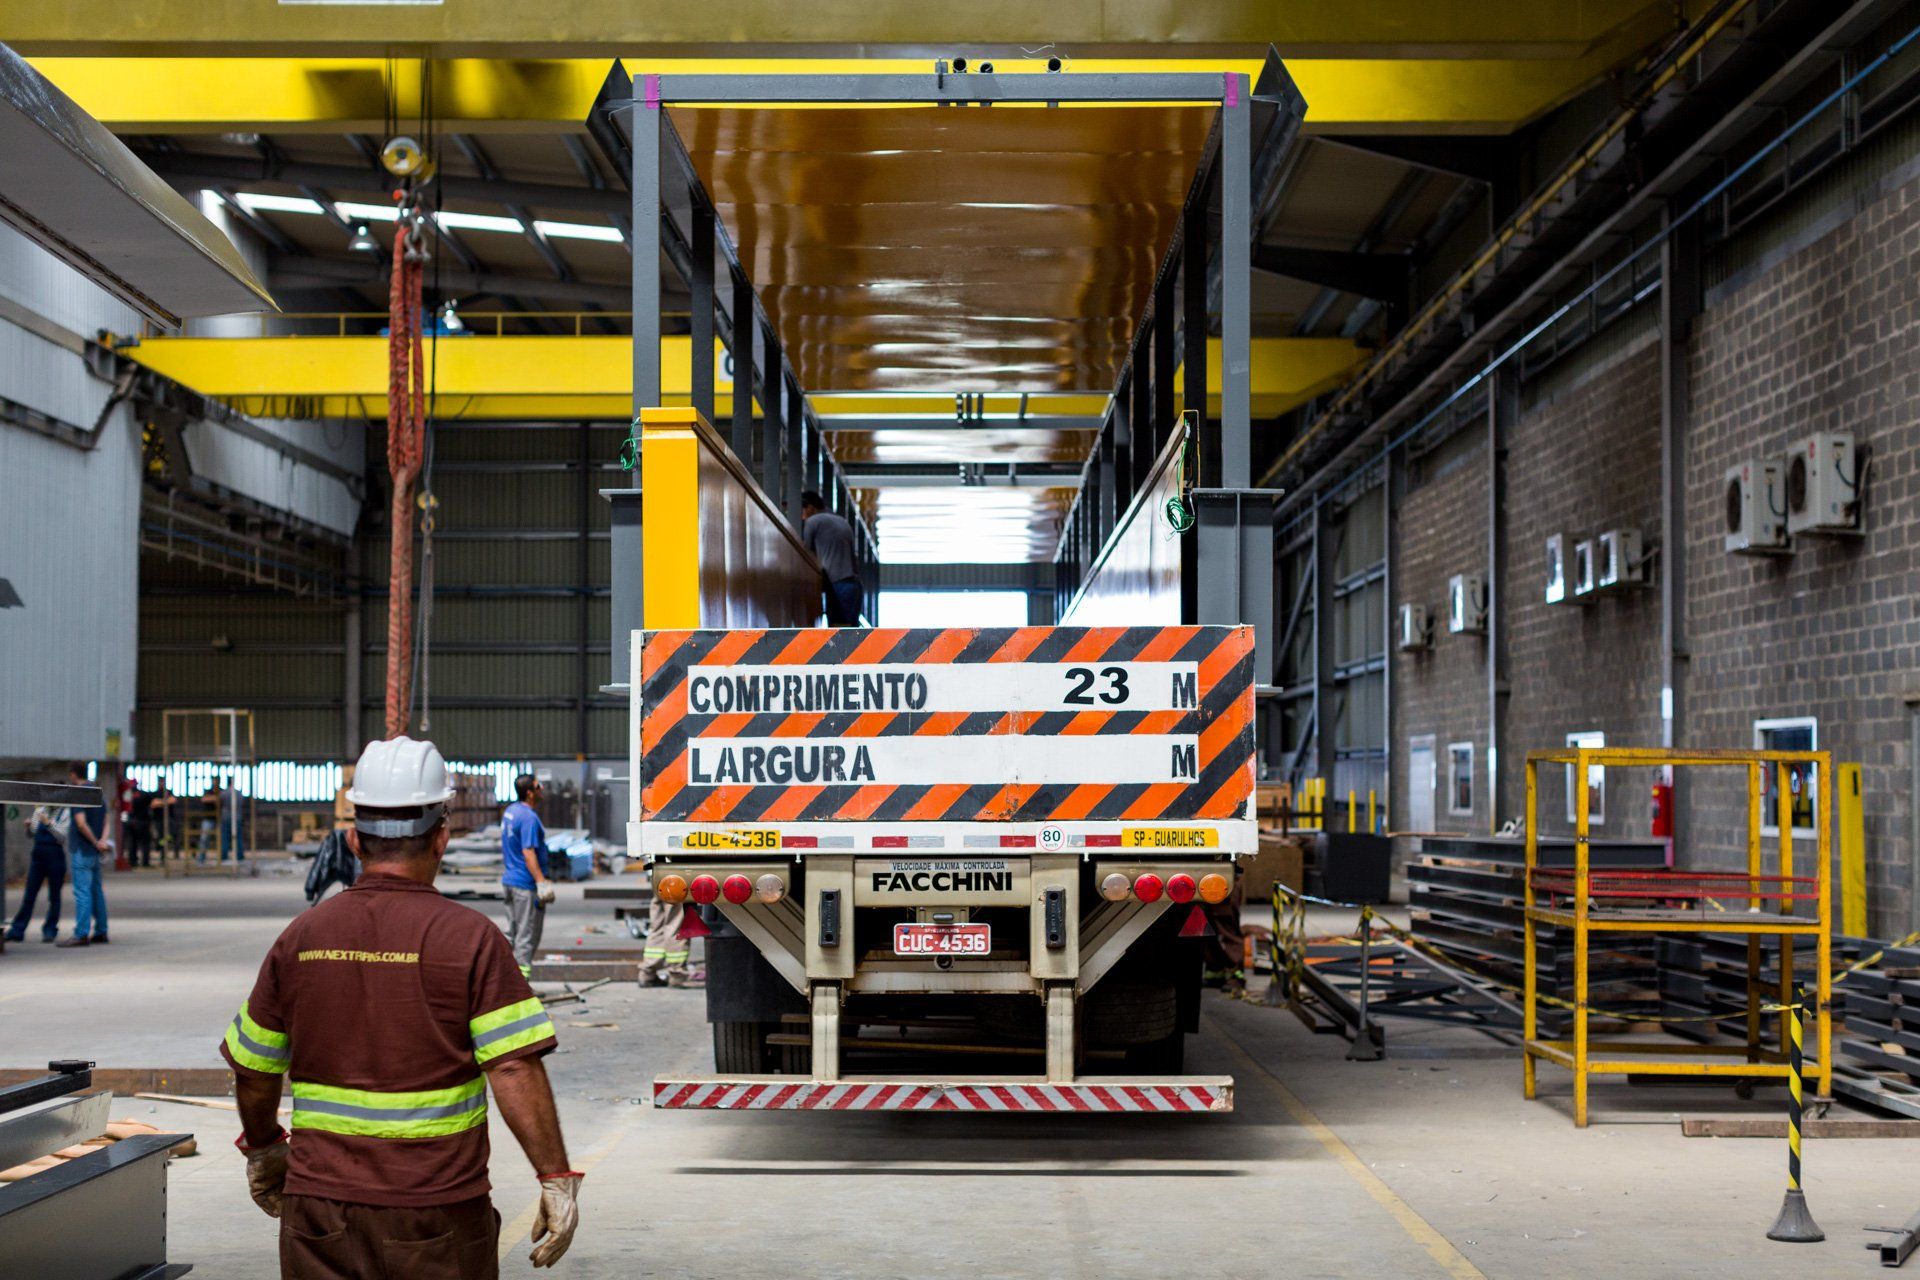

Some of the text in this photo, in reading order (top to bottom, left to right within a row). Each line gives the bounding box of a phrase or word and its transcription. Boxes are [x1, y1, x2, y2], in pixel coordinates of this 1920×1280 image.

[690, 666, 1197, 714] COMPRIMENTO 23 M
[691, 744, 1196, 785] LARGURA M
[1043, 830, 1061, 842] 80
[1134, 831, 1146, 847] SP
[892, 861, 932, 871] VELOCIDADE
[963, 861, 1005, 870] CONTROLADA
[872, 872, 1013, 892] FACCHINI
